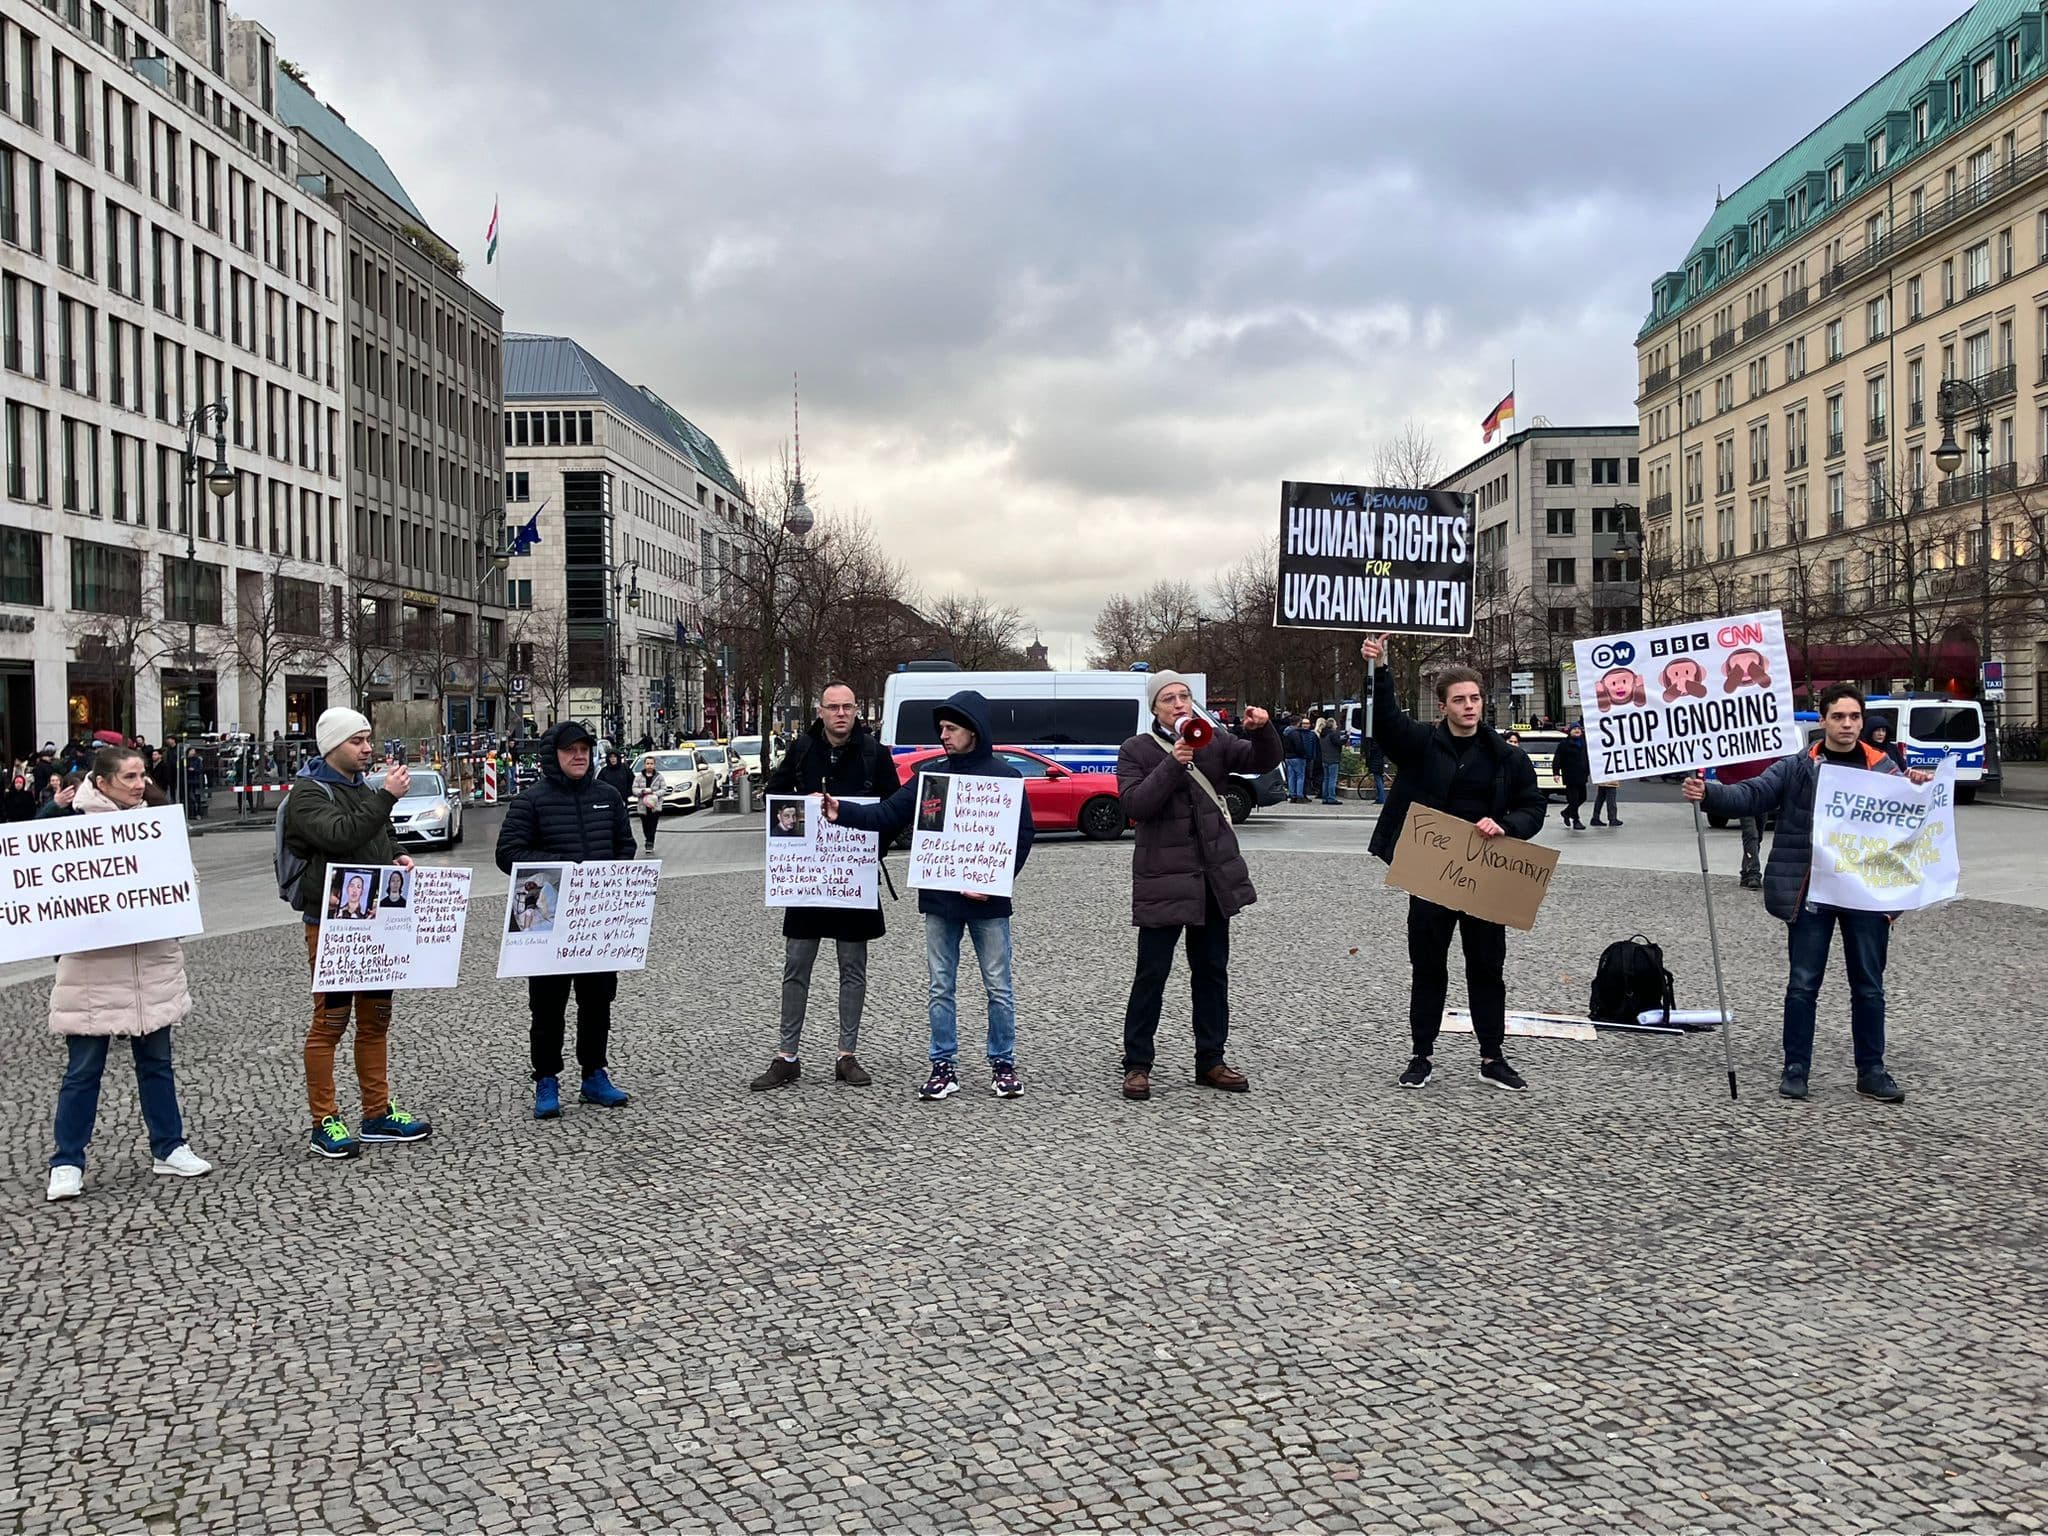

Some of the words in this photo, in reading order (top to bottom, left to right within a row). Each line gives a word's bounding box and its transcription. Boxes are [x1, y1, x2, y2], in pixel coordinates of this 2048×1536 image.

[1330, 491, 1355, 506] WE
[1362, 493, 1428, 511] DEMAND
[1288, 507, 1376, 559] HUMAN
[1382, 513, 1467, 564] RIGHTS
[1365, 560, 1392, 576] FOR
[1284, 573, 1410, 624] UKRAINIAN
[1415, 580, 1466, 627] MEN
[1717, 623, 1763, 648] CNN
[514, 679, 522, 690] U
[1600, 710, 1658, 748] STOP
[1666, 692, 1778, 738] IGNORING
[1602, 738, 1713, 775] ZELENSKIY'S
[1716, 726, 1783, 757] CRIMES
[957, 777, 972, 791] he
[1825, 804, 1844, 818] TO
[1832, 791, 1926, 816] EVERYONE
[0, 837, 20, 857] IE
[28, 826, 104, 854] UKRAINE
[112, 820, 162, 844] MUSS
[1414, 814, 1452, 850] Free
[1860, 836, 1888, 852] NO
[13, 867, 44, 889] DIE
[51, 855, 138, 884] GRENZEN
[572, 864, 584, 876] he
[936, 865, 956, 878] the
[1439, 860, 1477, 894] Men
[590, 878, 600, 888] he
[38, 895, 112, 922] MÄNNER
[117, 880, 190, 910] OFFNEN!
[320, 956, 333, 969] to
[337, 956, 356, 970] the
